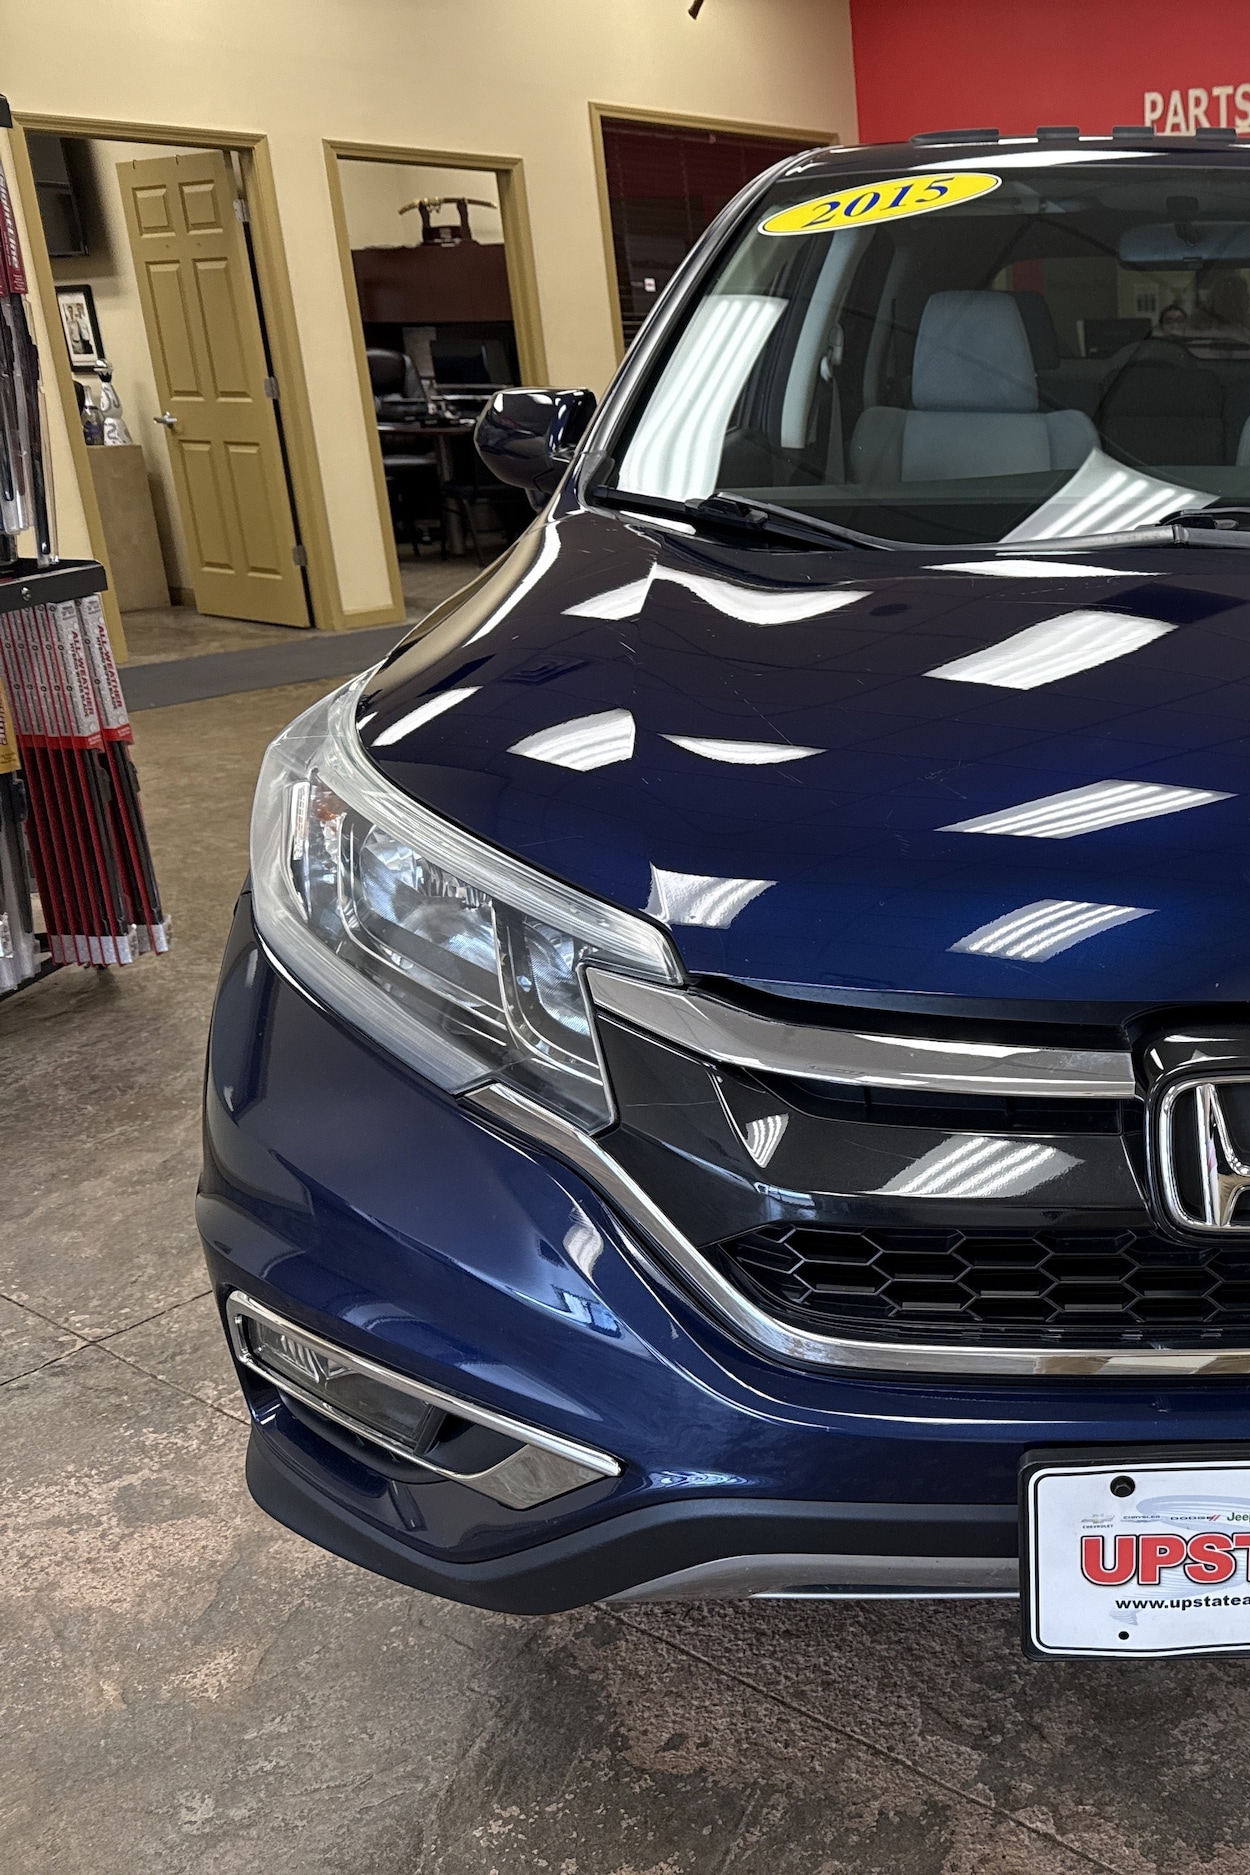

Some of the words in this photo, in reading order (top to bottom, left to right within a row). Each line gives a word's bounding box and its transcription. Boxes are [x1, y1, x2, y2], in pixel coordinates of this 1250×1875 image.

[801, 177, 955, 228] 2015
[71, 630, 95, 716] ALL-WEATHER
[97, 624, 123, 708] ALL-WEATHER
